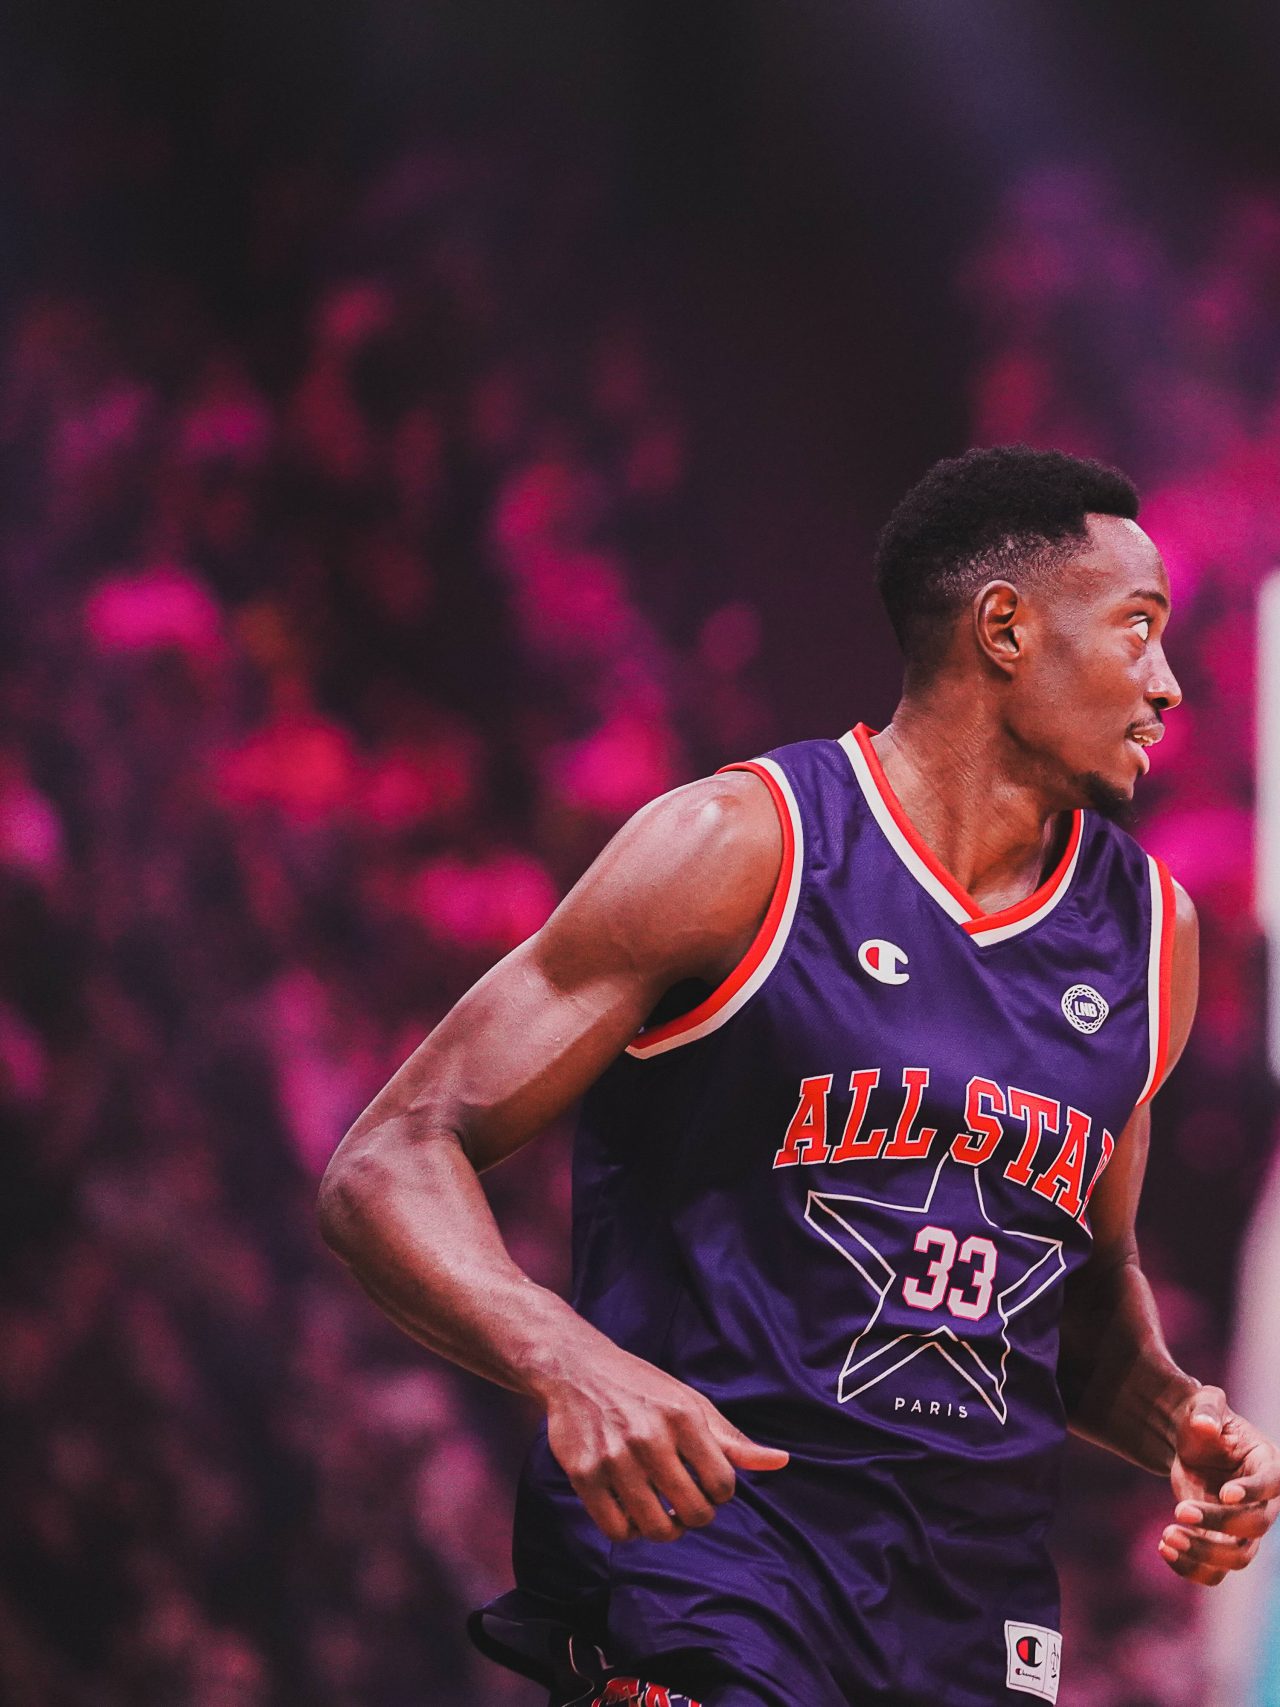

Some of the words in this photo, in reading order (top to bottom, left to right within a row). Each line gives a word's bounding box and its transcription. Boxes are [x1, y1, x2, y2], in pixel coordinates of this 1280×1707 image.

[1074, 1001, 1097, 1018] LNB
[772, 1067, 937, 1169] ALL
[950, 1076, 1115, 1239] STA
[902, 1225, 998, 1321] 33
[894, 1397, 968, 1419] PARIS
